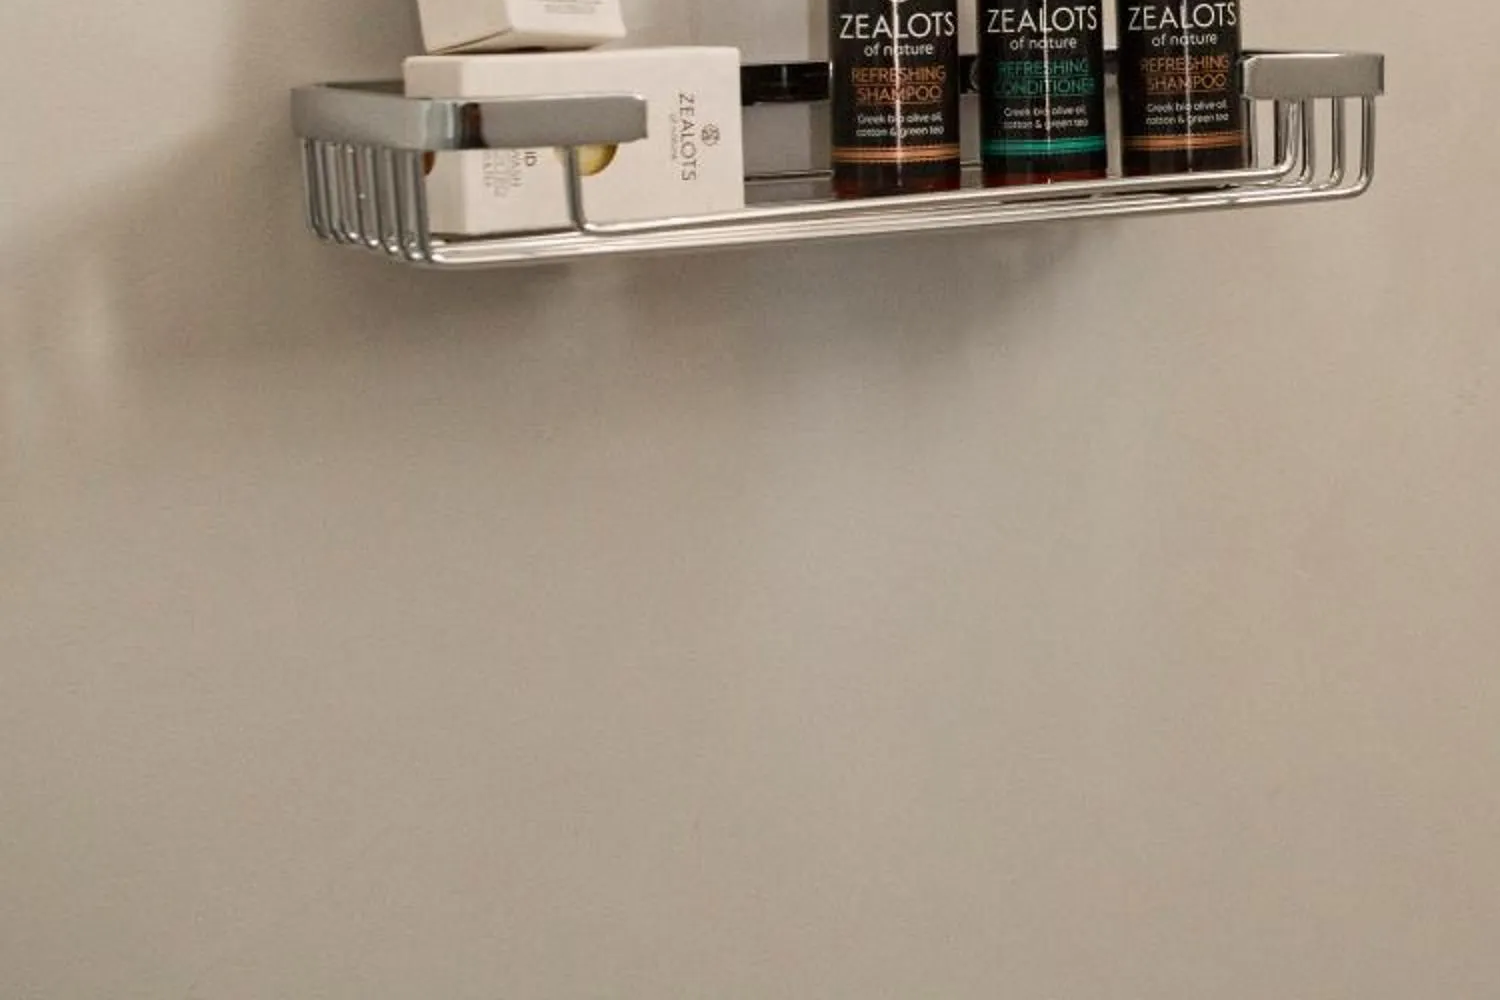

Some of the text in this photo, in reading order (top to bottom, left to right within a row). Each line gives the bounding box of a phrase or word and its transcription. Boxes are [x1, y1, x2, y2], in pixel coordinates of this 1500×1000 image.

[839, 11, 956, 39] ZEALOTS
[986, 5, 1097, 33] ZEALOTS
[1127, 1, 1237, 31] ZEALOTS
[863, 41, 935, 57] of nature
[1009, 35, 1078, 51] of nature
[1151, 32, 1218, 47] of nature
[997, 57, 1089, 76] REFRESHING
[1140, 54, 1229, 73] REFRESHING
[851, 64, 946, 83] REFRESHING
[1147, 73, 1226, 91] SHAMPOO
[856, 85, 943, 102] SHAMPOO
[678, 92, 697, 182] ZEALOTS
